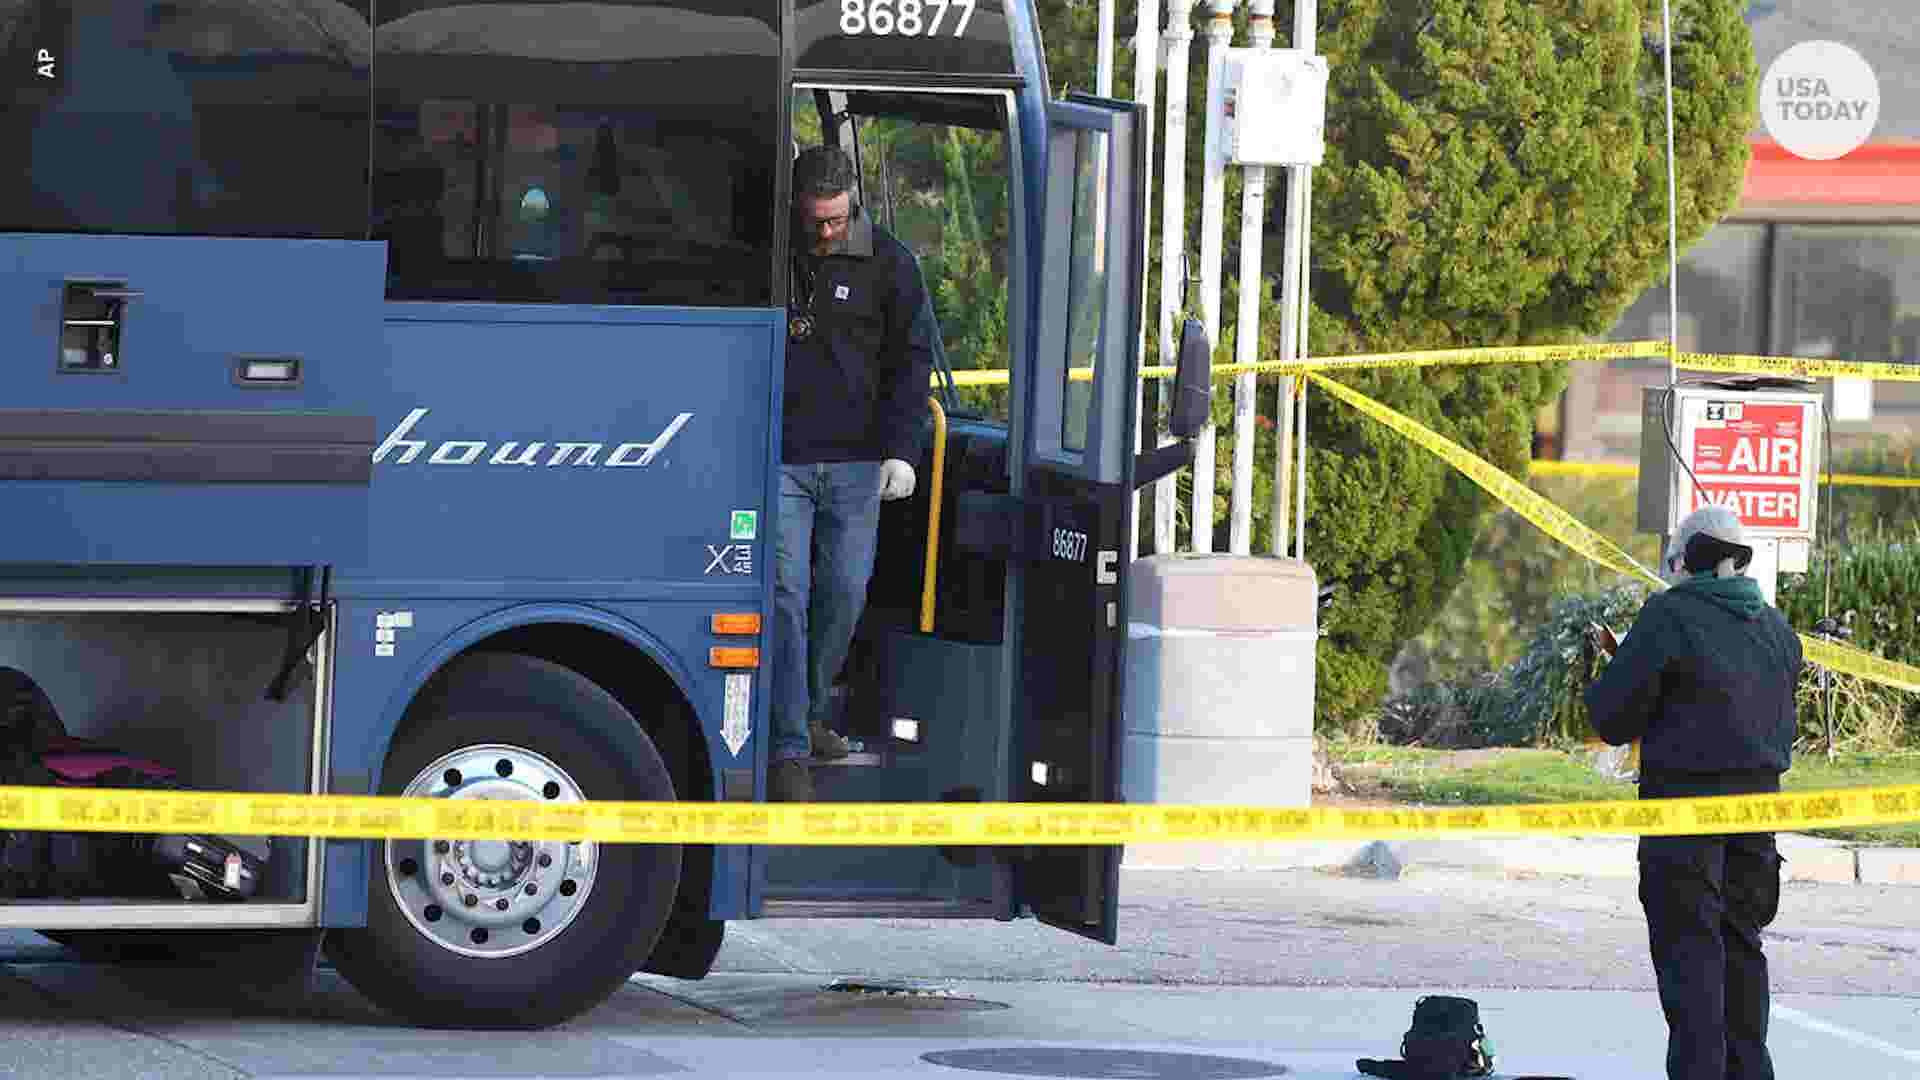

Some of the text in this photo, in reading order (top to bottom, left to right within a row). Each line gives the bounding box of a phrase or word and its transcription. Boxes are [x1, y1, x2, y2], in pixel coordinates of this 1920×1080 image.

[840, 0, 976, 37] 86877
[1727, 436, 1798, 472] AIR
[1053, 527, 1087, 563] 86877
